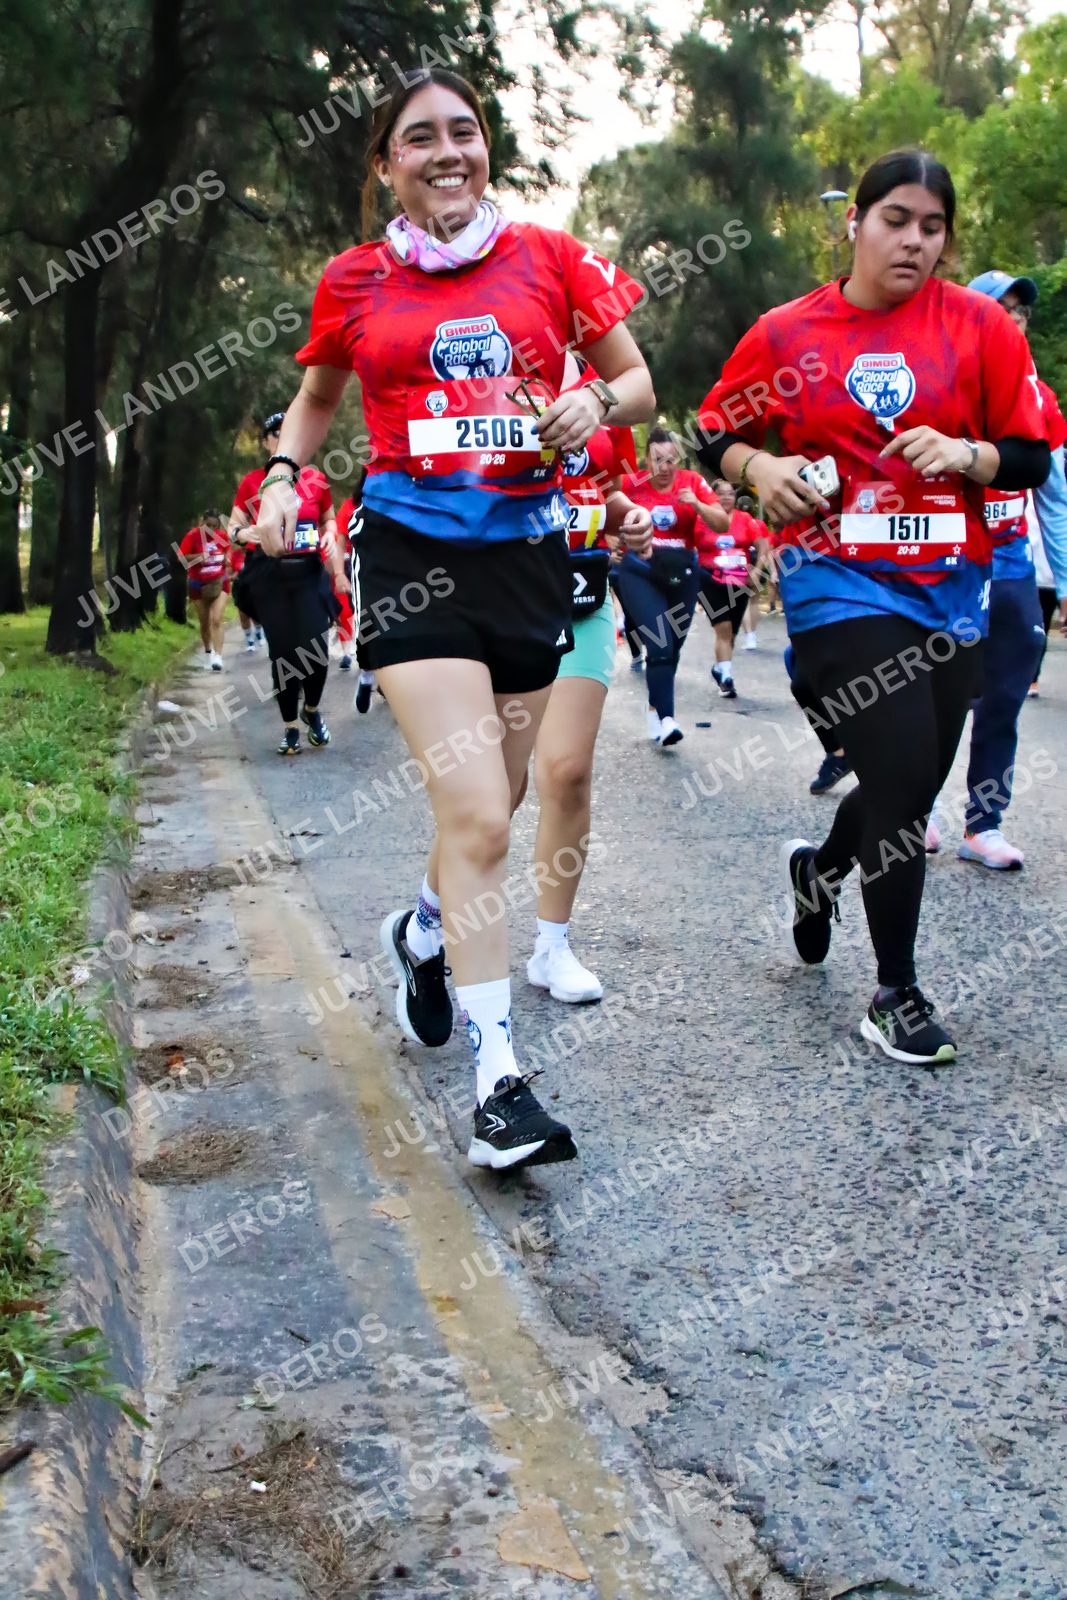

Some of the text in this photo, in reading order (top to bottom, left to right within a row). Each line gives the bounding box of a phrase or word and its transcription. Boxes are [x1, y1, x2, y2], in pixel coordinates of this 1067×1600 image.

[445, 323, 490, 336] BIMBO
[450, 336, 491, 355] Global
[444, 352, 477, 367] Race
[861, 359, 898, 368] BIMBO
[863, 370, 898, 382] Global
[856, 381, 885, 393] Race
[456, 418, 524, 449] 2506
[533, 469, 547, 478] 5K
[888, 515, 930, 541] 1511
[945, 556, 958, 565] 5K
